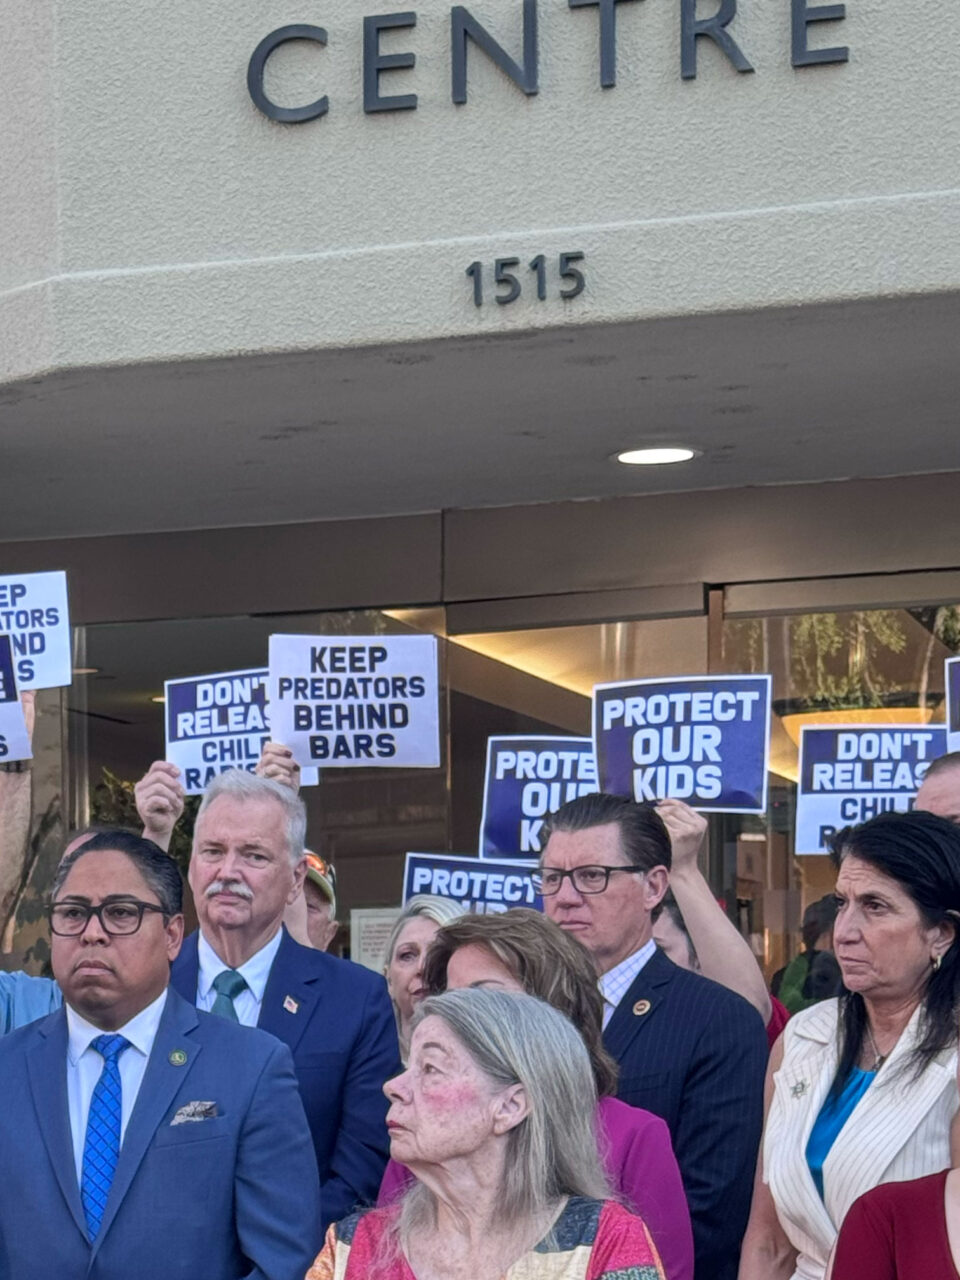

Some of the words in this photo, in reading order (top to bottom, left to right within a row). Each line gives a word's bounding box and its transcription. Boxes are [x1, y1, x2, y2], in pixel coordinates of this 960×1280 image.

[246, 0, 849, 124] CENTRE
[466, 251, 586, 307] 1515
[310, 646, 387, 673] KEEP
[279, 677, 425, 700] PREDATORS
[294, 704, 409, 731] BEHIND
[603, 691, 760, 730] PROTECT
[310, 734, 396, 760] BARS
[633, 725, 722, 765] OUR
[837, 733, 933, 760] DON'T
[496, 751, 596, 780] PROTE
[633, 765, 722, 803] KIDS
